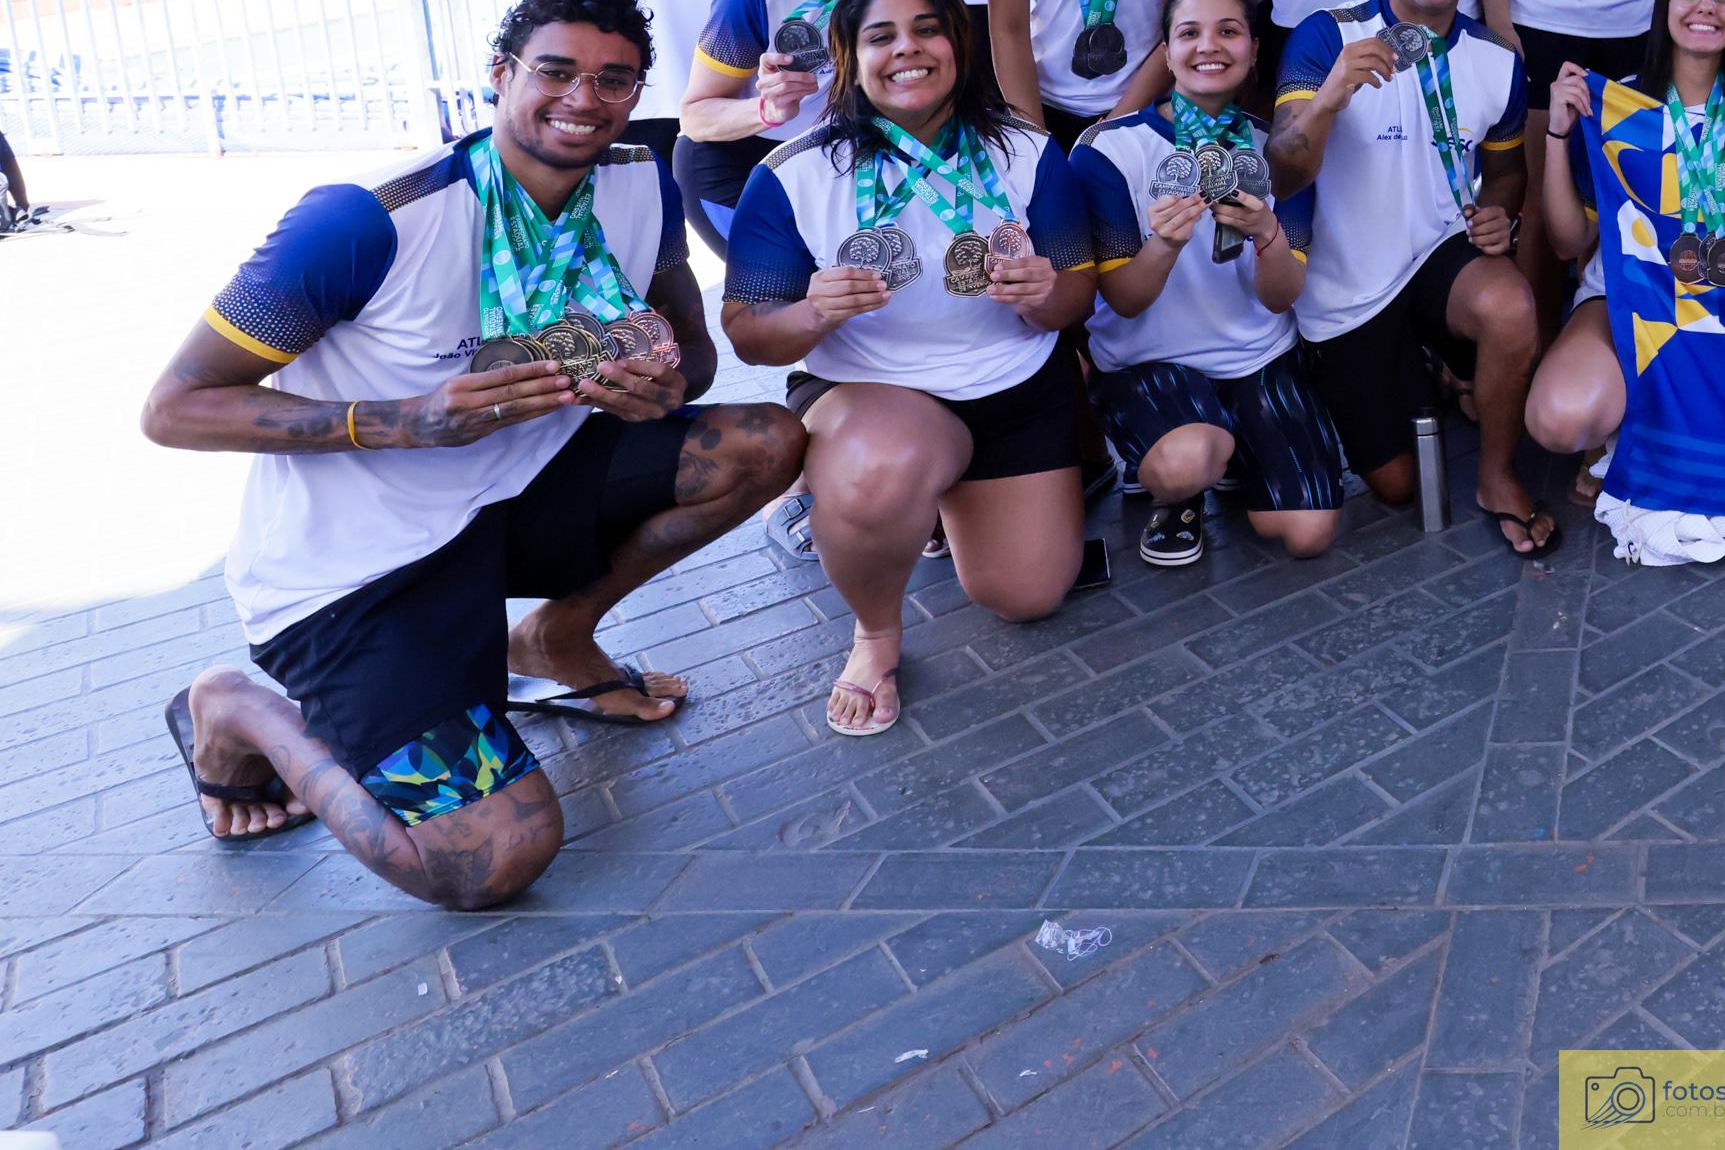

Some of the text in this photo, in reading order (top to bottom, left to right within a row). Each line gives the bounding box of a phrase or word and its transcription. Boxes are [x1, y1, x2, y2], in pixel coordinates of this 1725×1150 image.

[1154, 183, 1195, 192] CAMPEONATO
[458, 336, 481, 350] ATL
[434, 350, 474, 360] João Vi
